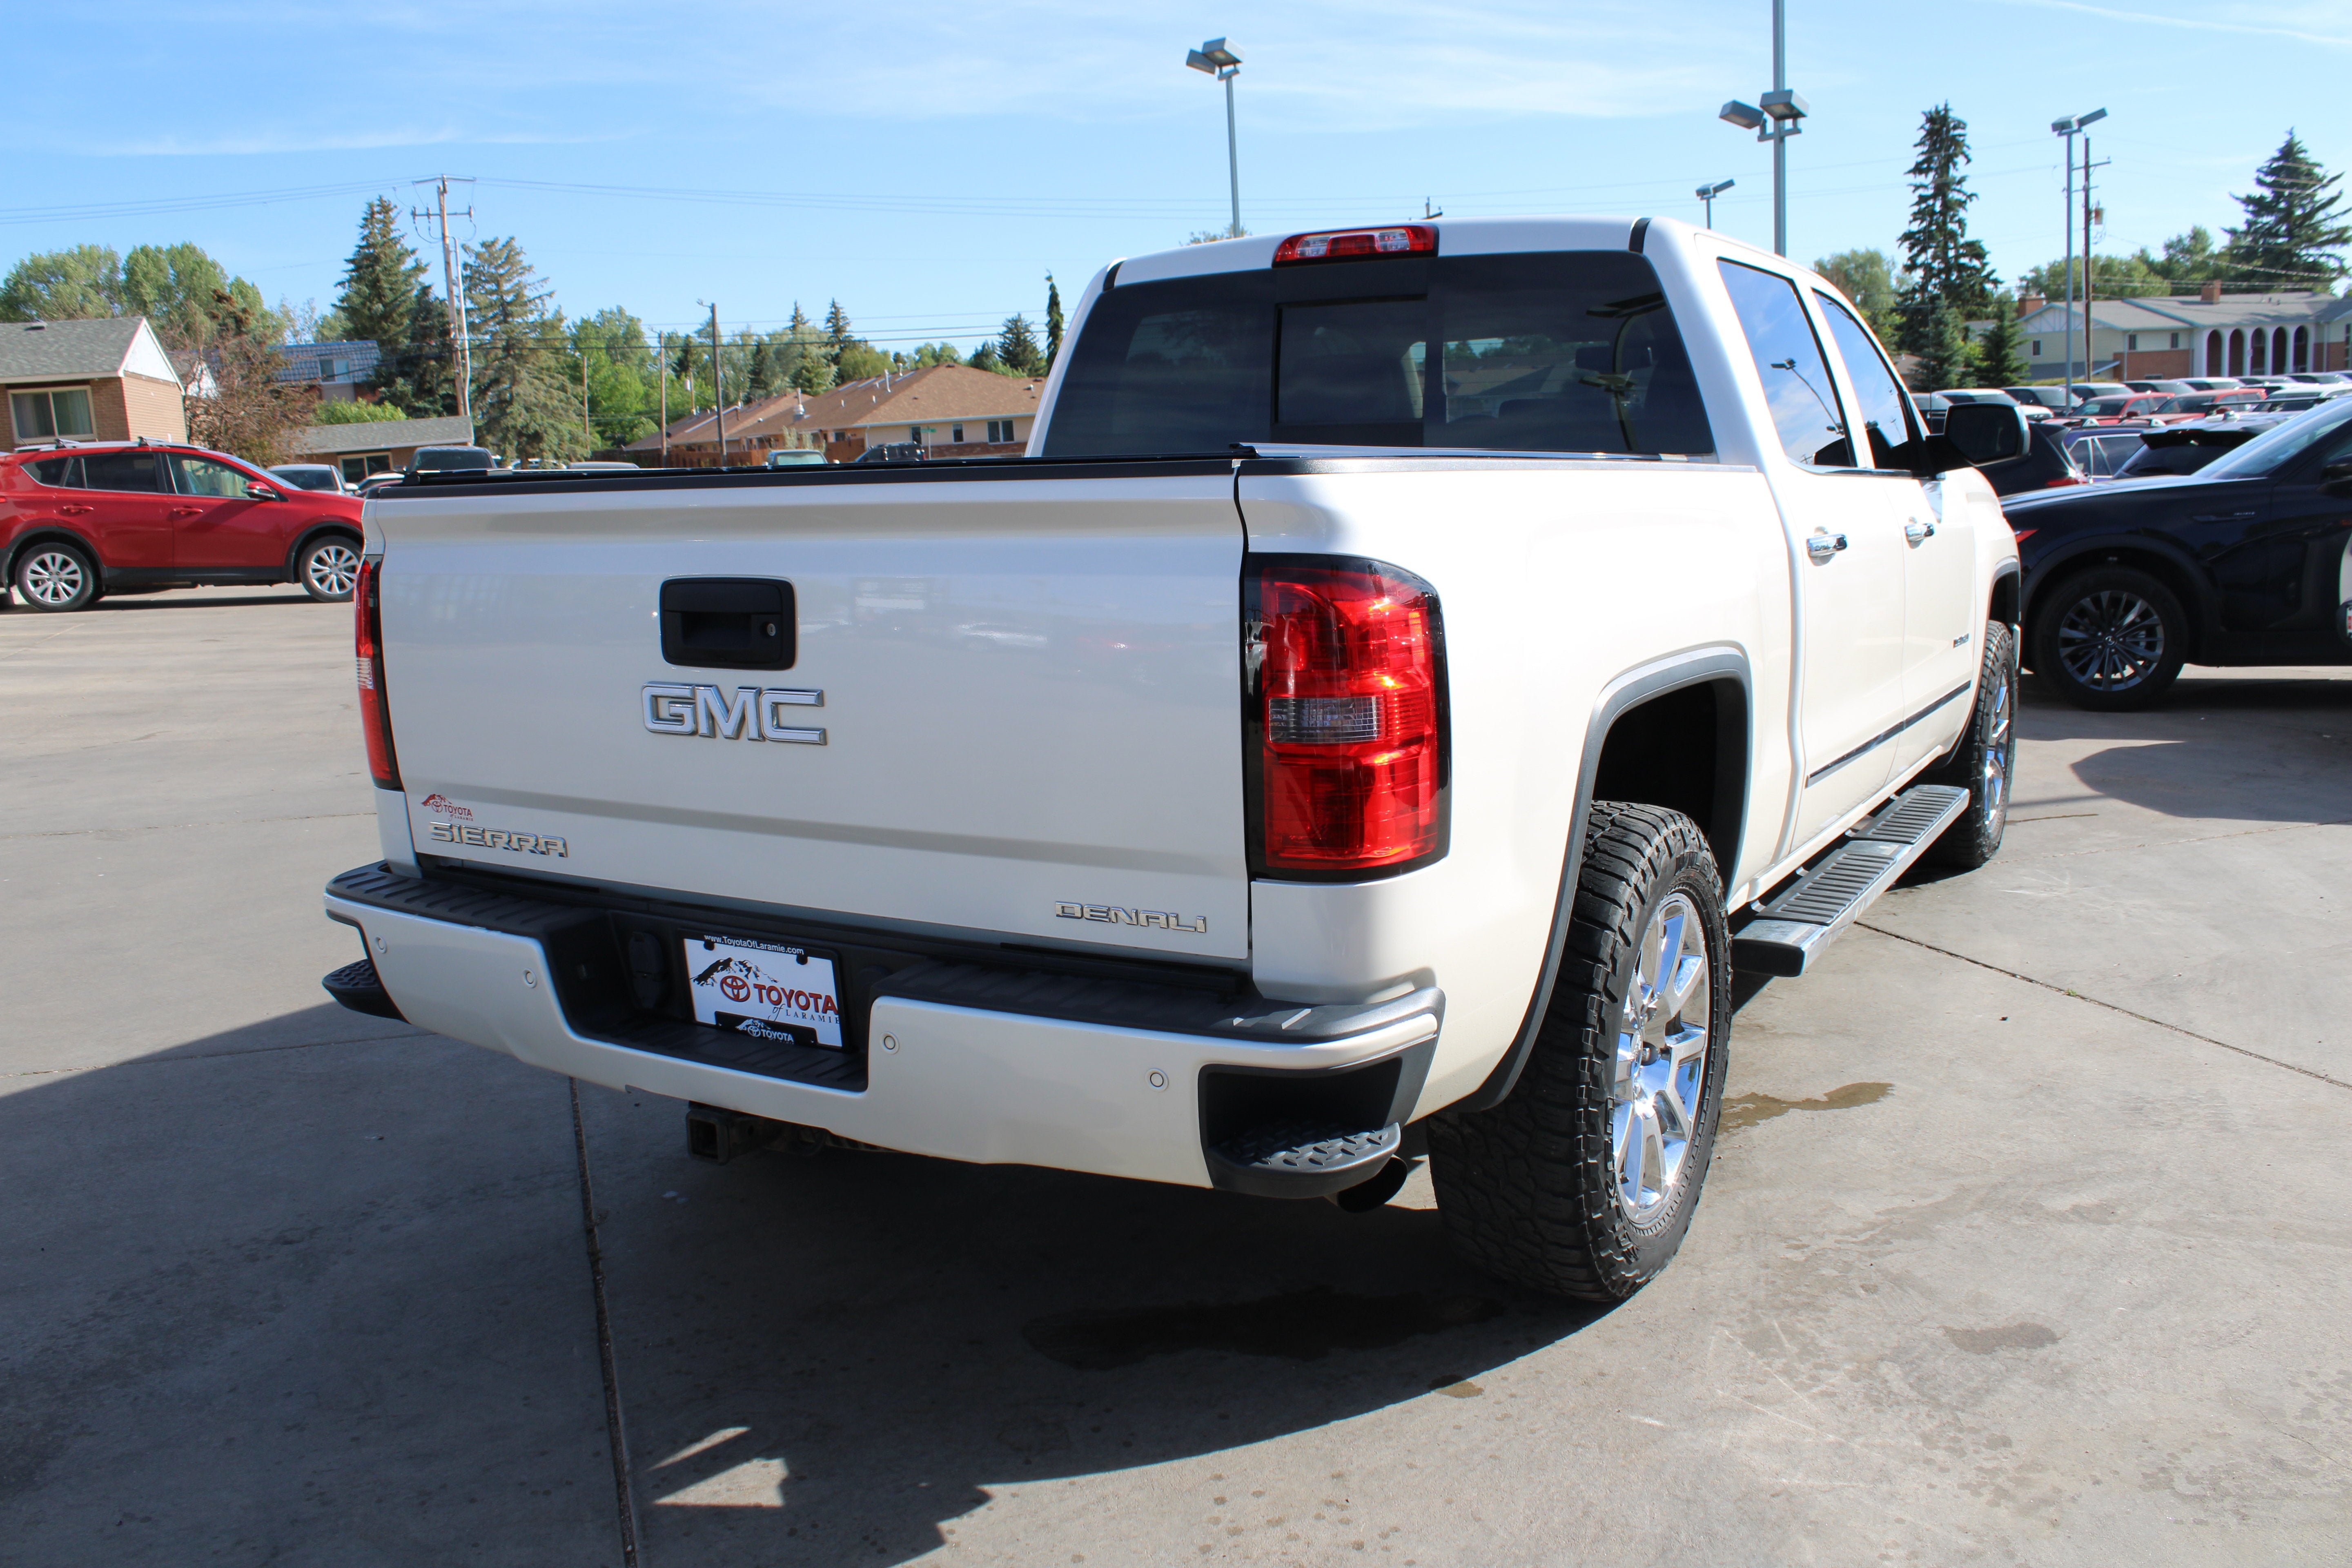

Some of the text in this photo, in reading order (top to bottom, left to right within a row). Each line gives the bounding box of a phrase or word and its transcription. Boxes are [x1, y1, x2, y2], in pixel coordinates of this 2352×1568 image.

[641, 681, 827, 746] GMC
[443, 804, 472, 817] TOYOTA
[429, 821, 568, 858] SIERRA
[1055, 900, 1207, 933] DENALI
[704, 934, 804, 955] www.ToyotaOfLaramie.com
[754, 983, 839, 1015] TOYOTA
[768, 1003, 840, 1024] of LARAMIE
[760, 1029, 794, 1042] TOYOTA
